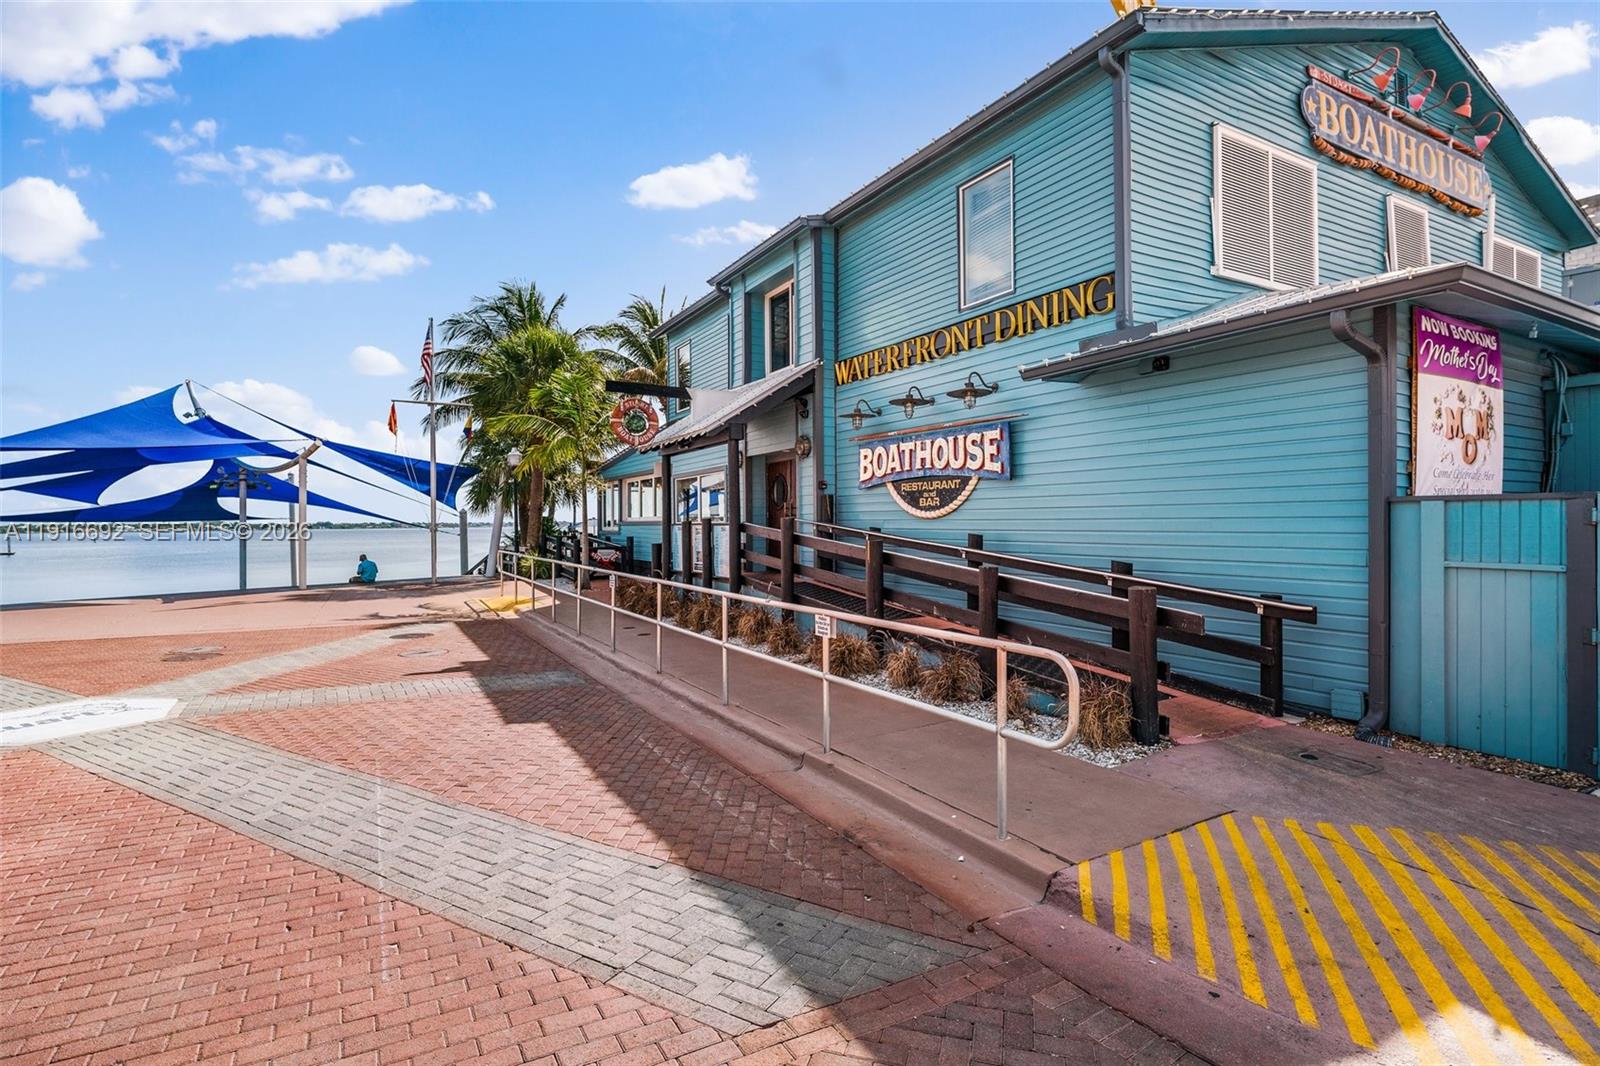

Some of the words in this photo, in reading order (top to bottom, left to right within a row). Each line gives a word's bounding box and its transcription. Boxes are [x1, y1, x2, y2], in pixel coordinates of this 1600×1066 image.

[1316, 90, 1483, 199] BOATHOUSE
[834, 315, 989, 386] WATERFRONT
[993, 275, 1116, 343] DINING
[1421, 315, 1449, 337] NOW
[1450, 324, 1498, 351] BOOKING
[1420, 338, 1476, 370] Mother's
[1475, 351, 1500, 383] Day
[858, 428, 1003, 482] BOATHOUSE
[901, 479, 961, 491] RESTAURANT
[919, 497, 940, 506] BAR
